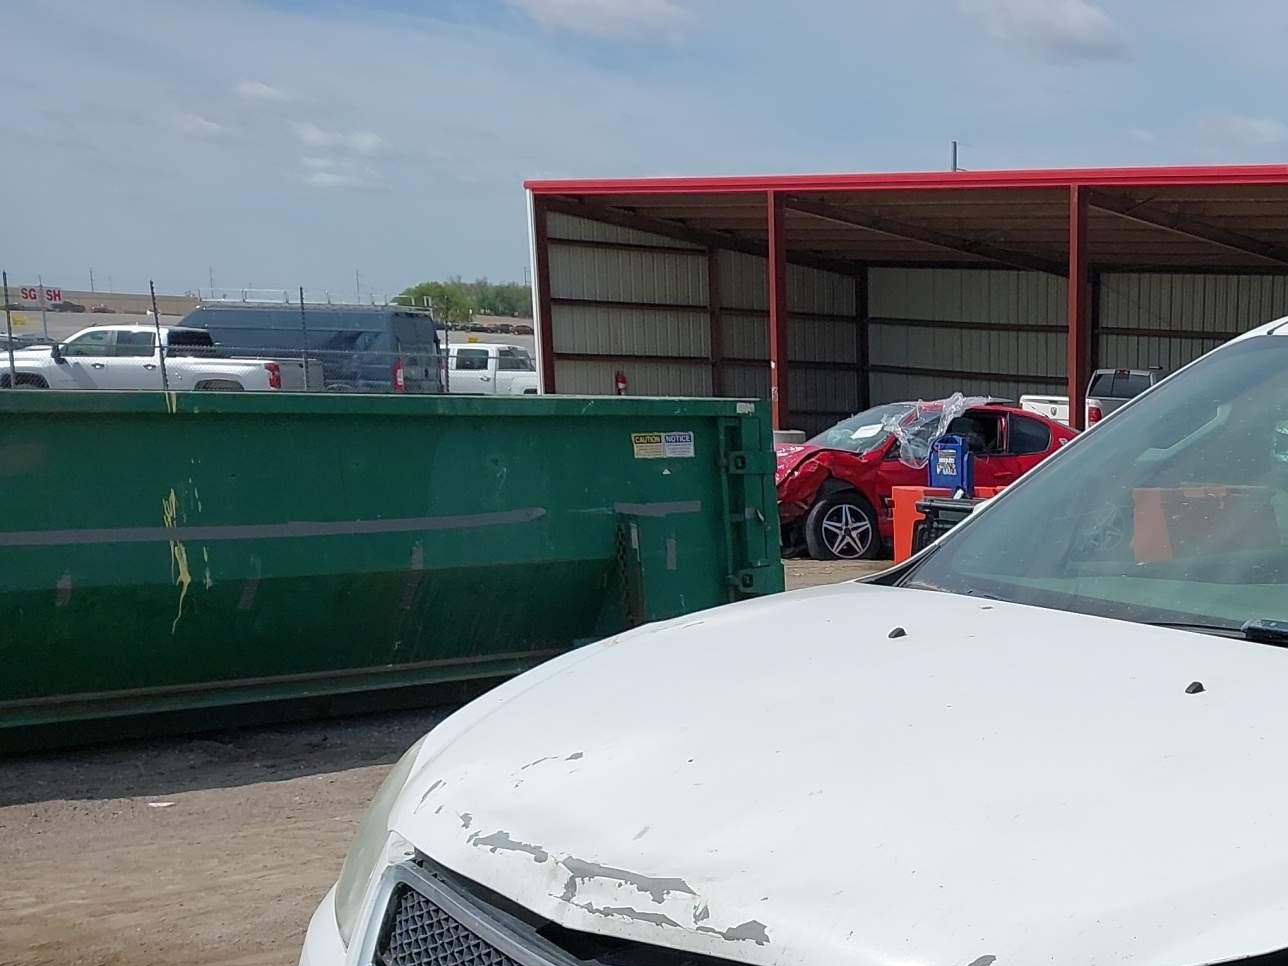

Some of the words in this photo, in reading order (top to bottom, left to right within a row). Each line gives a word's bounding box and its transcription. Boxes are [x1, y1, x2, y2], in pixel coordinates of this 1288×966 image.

[20, 287, 37, 300] SG
[46, 289, 62, 301] SH
[635, 435, 661, 444] CAUTION
[665, 435, 691, 443] NOTICE
